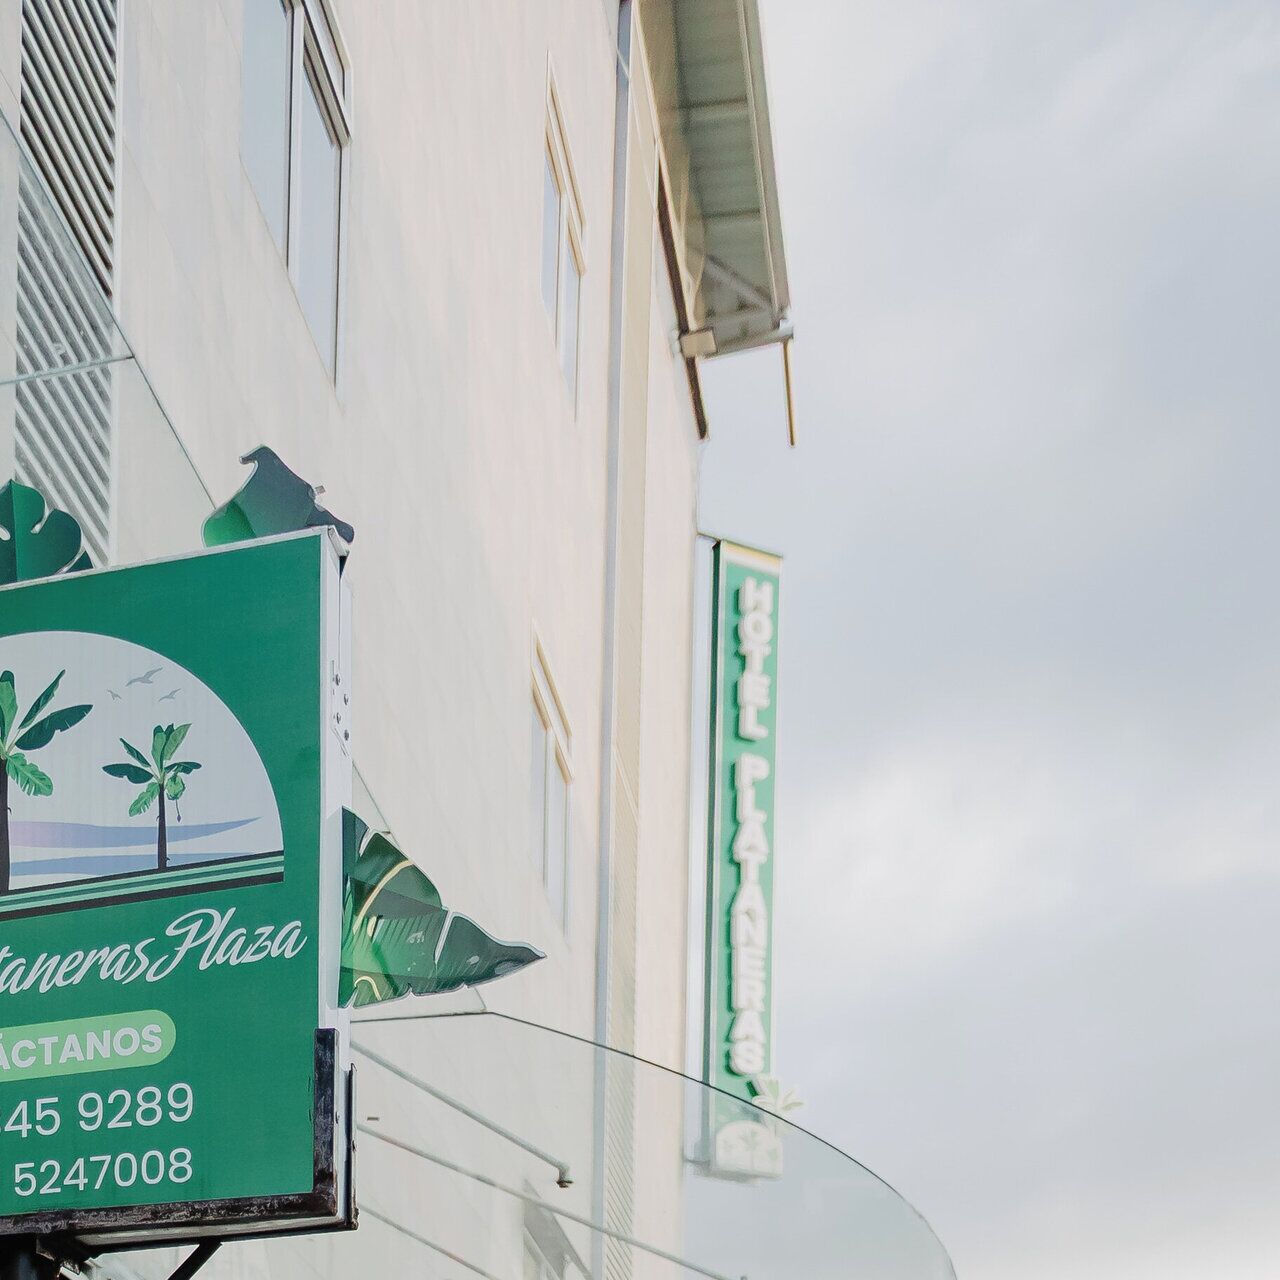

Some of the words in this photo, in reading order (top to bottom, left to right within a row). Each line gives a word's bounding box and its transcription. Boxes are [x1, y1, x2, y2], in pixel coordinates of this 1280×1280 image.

[735, 576, 773, 741] HOTEL
[148, 907, 308, 983] Plaza
[728, 752, 770, 1075] PLATANERAS
[78, 1082, 194, 1131] 9289
[14, 1147, 193, 1197] 5247008
